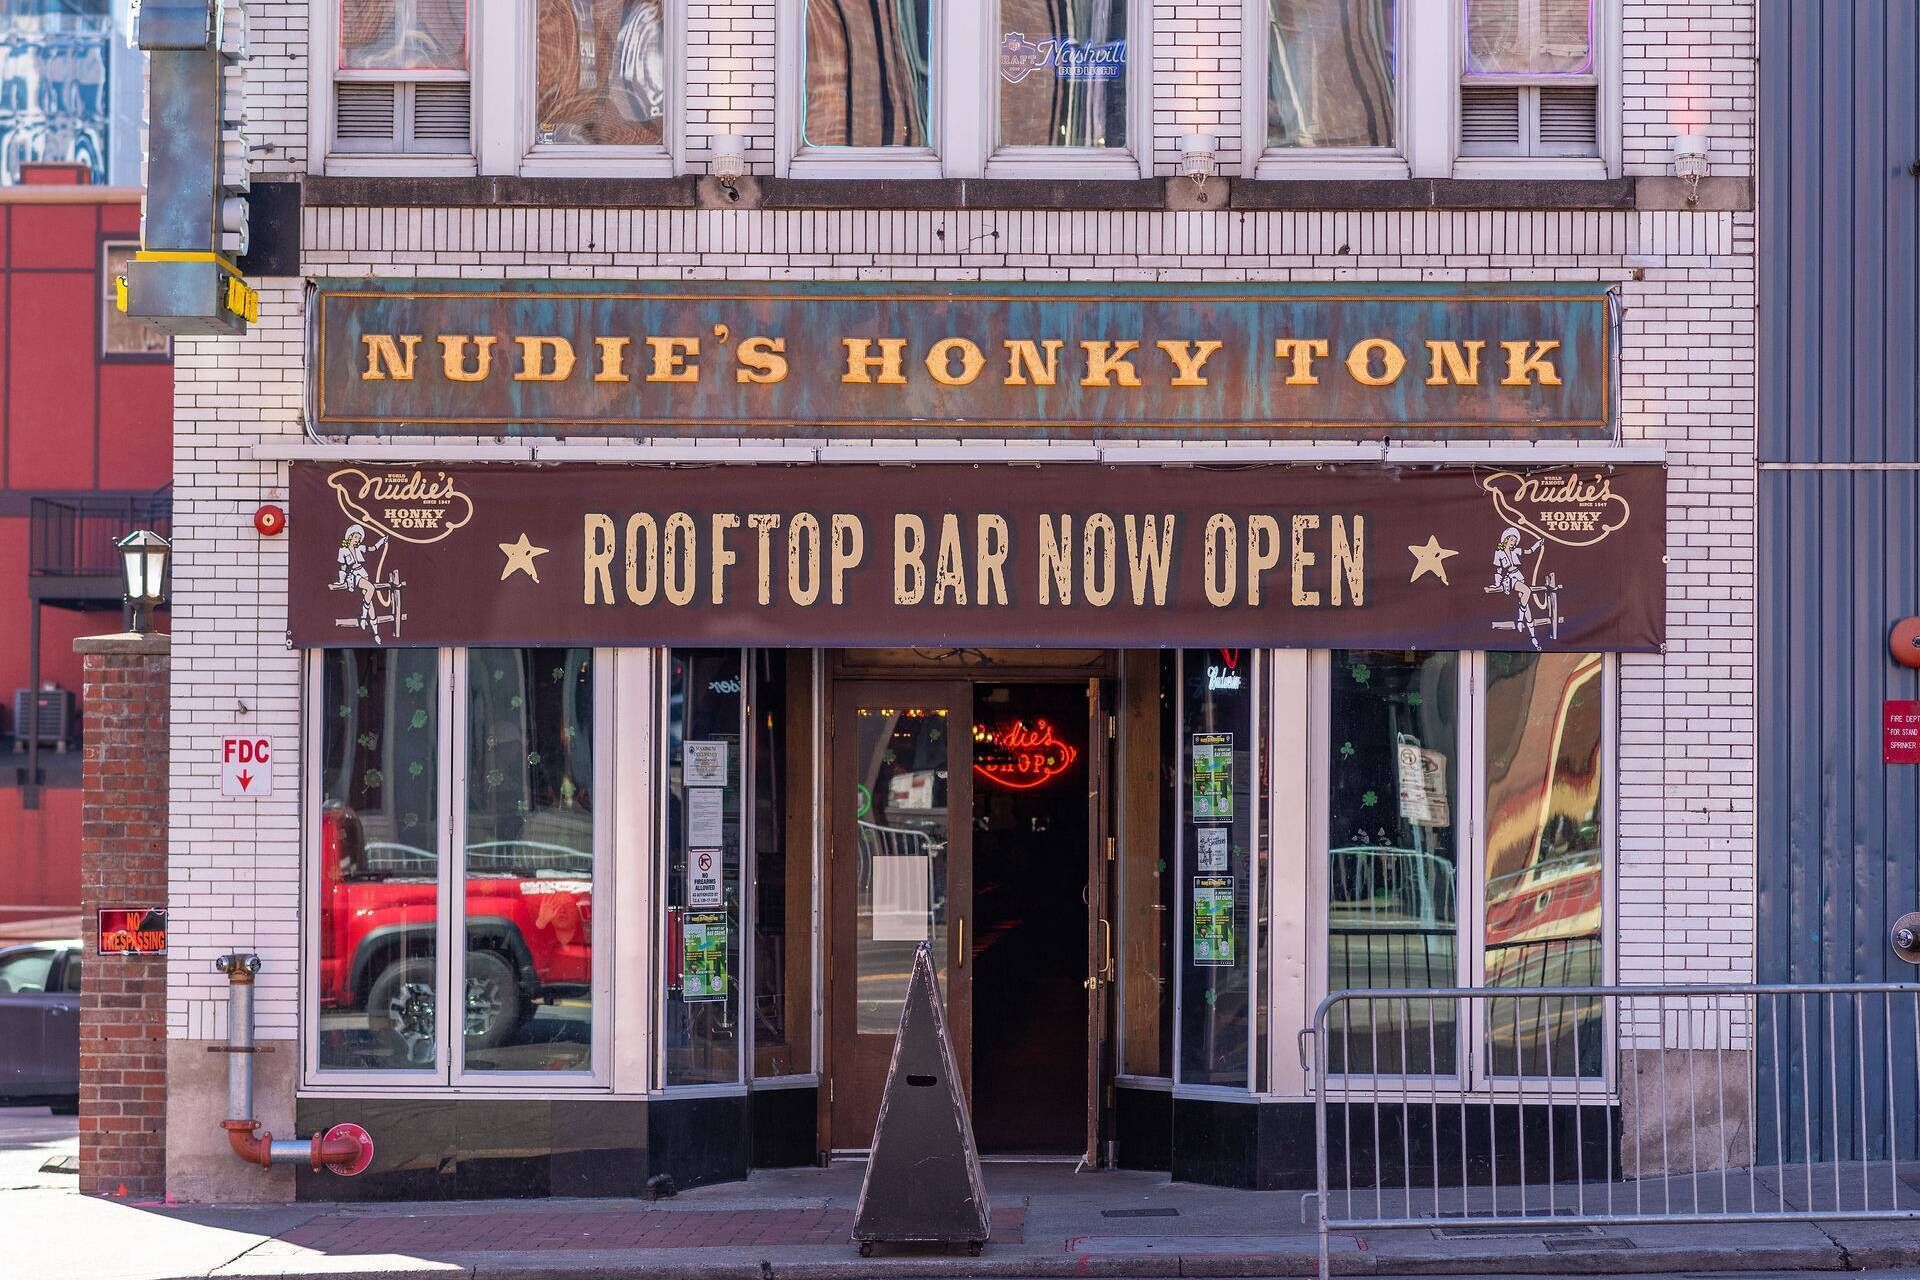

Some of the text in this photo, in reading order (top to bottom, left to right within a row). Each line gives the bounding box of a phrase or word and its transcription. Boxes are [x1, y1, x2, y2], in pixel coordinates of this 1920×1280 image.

[1035, 39, 1127, 67] Nashvill
[1001, 55, 1037, 65] RAFT
[1058, 66, 1118, 76] BUD LIGHT
[360, 322, 1563, 387] NUDIE'S HONKY TONK
[384, 509, 446, 519] HONKY
[1540, 511, 1602, 521] HONKY
[390, 518, 439, 528] TONK
[1546, 521, 1595, 531] TONK
[584, 512, 1365, 607] ROOFTOP BAR NOW OPEN
[1890, 715, 1903, 723] FIRE
[1890, 728, 1918, 736] FOR STAND
[224, 739, 270, 764] FDC
[126, 911, 140, 931] NO
[102, 931, 165, 951] TRESPASSING
